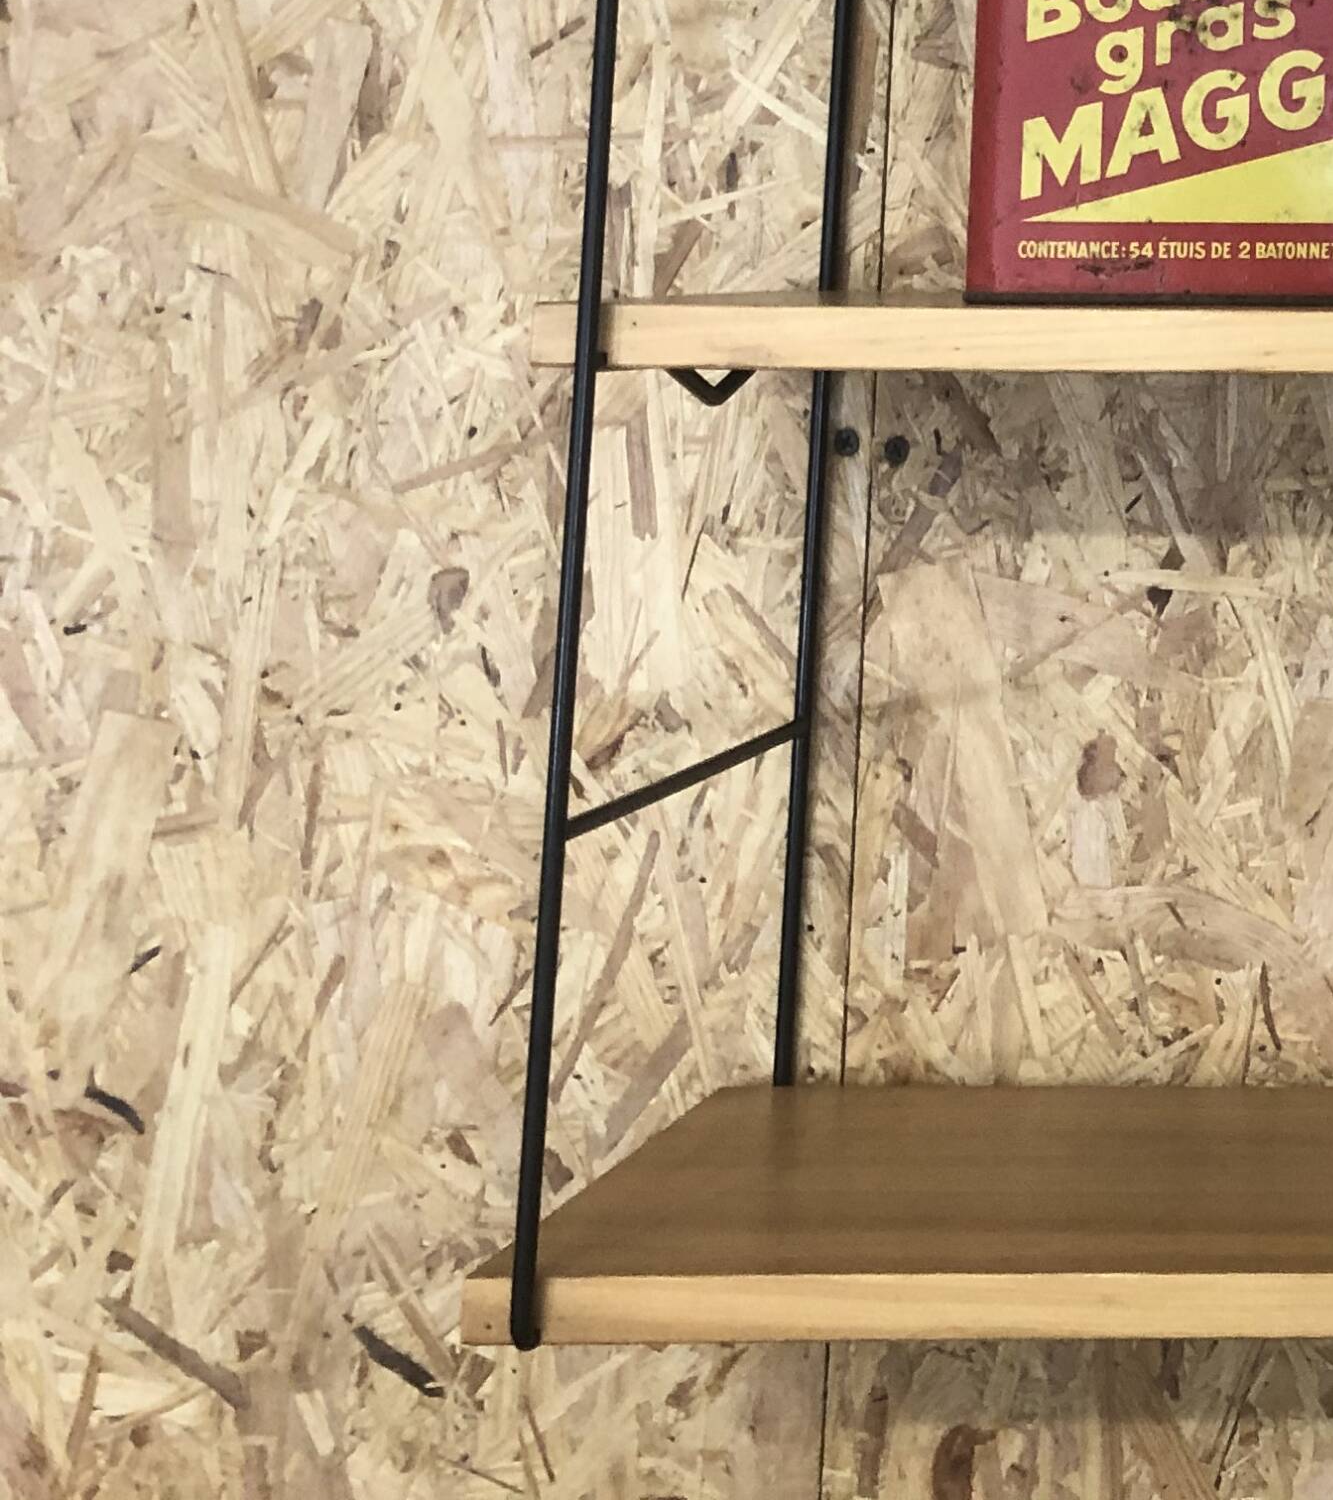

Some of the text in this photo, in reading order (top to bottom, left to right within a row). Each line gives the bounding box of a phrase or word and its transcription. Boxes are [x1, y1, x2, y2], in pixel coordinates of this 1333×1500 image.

[1158, 237, 1206, 259] ÉTUIS
[1211, 242, 1231, 259] DE
[1238, 243, 1250, 259] 2
